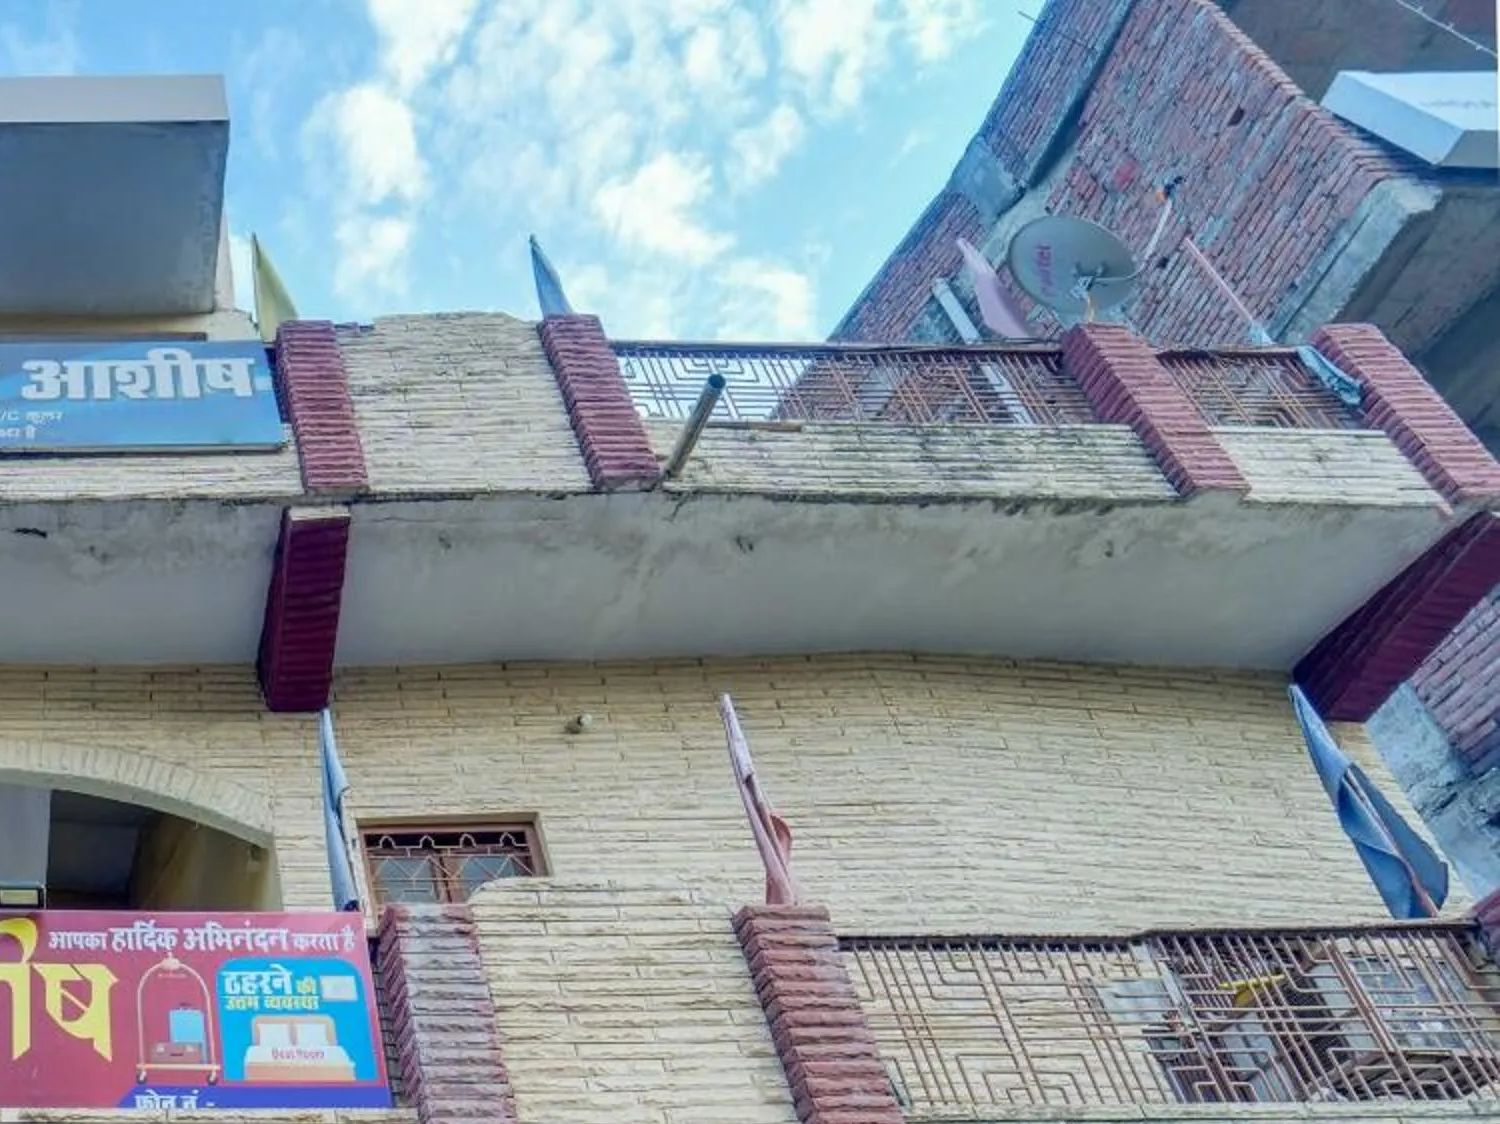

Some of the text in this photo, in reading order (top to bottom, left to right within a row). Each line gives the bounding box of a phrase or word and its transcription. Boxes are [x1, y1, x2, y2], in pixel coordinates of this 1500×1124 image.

[21, 348, 255, 400] आशीष
[48, 920, 356, 953] आपका हार्दिक अभिनंदन करता है
[221, 963, 293, 995] ठहरने
